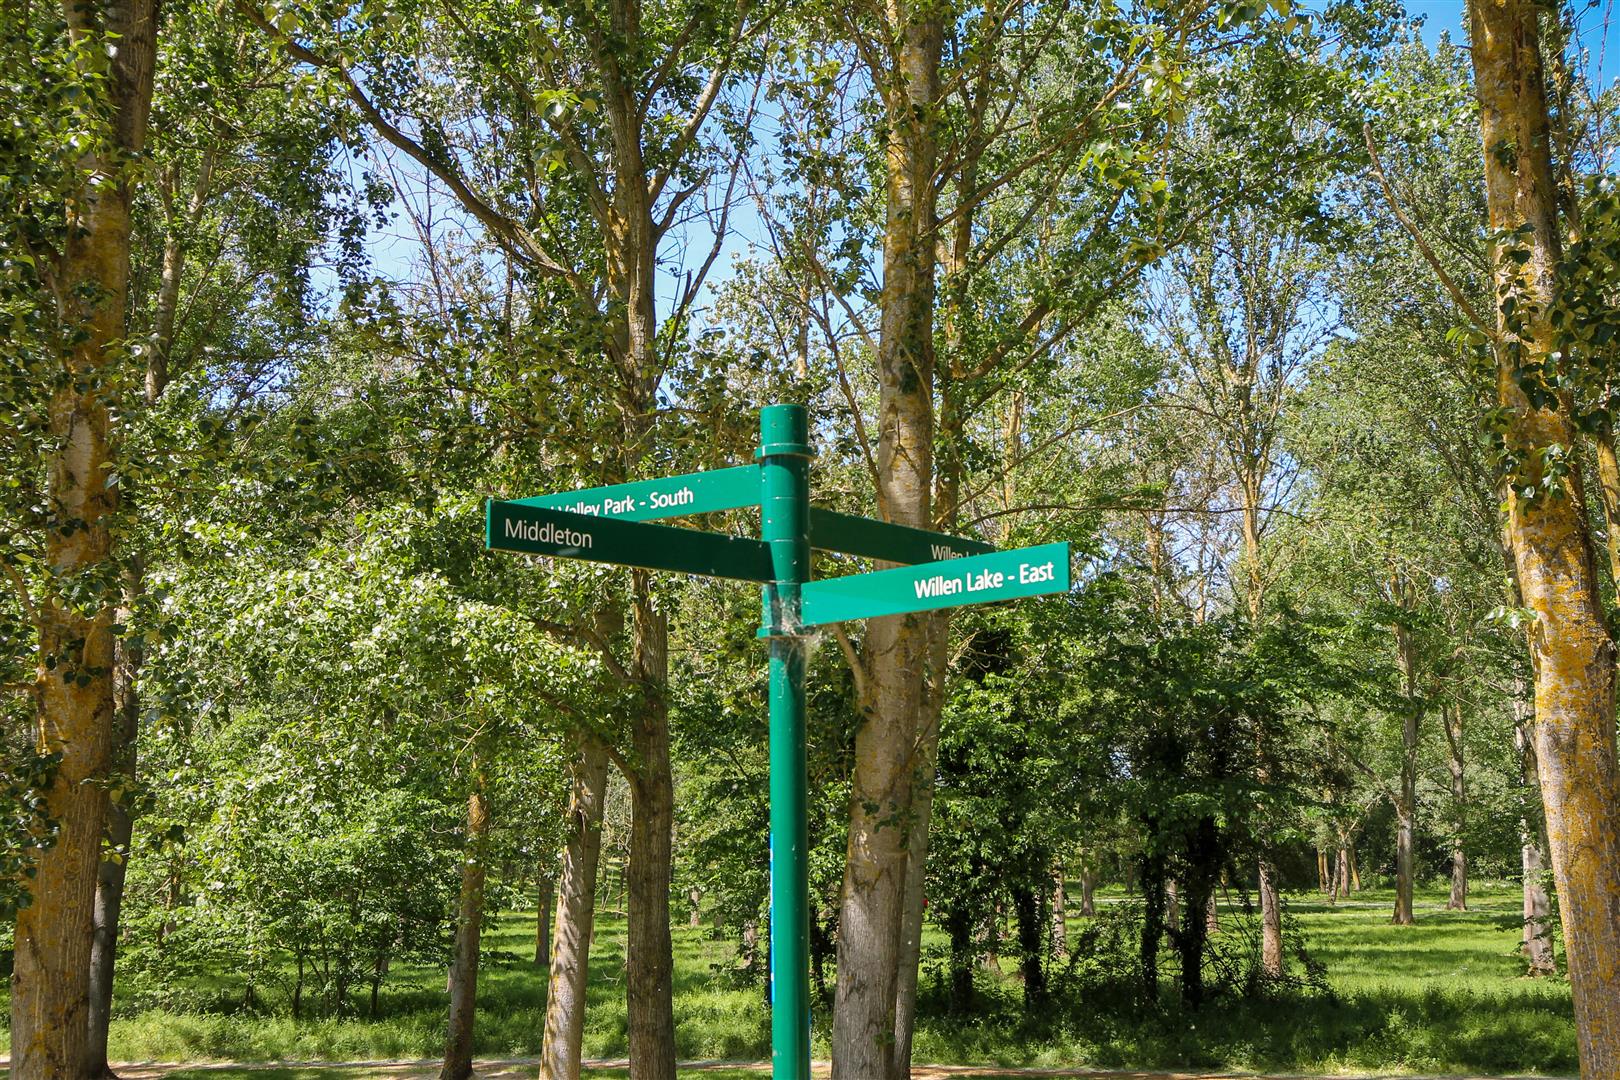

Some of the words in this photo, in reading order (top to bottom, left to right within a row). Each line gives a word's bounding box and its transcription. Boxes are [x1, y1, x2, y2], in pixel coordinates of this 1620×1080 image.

[604, 495, 635, 515] Park
[649, 487, 694, 509] South
[505, 518, 592, 549] Middleton
[914, 575, 962, 599] Willen
[966, 568, 1004, 592] Lake
[1019, 561, 1055, 584] East
